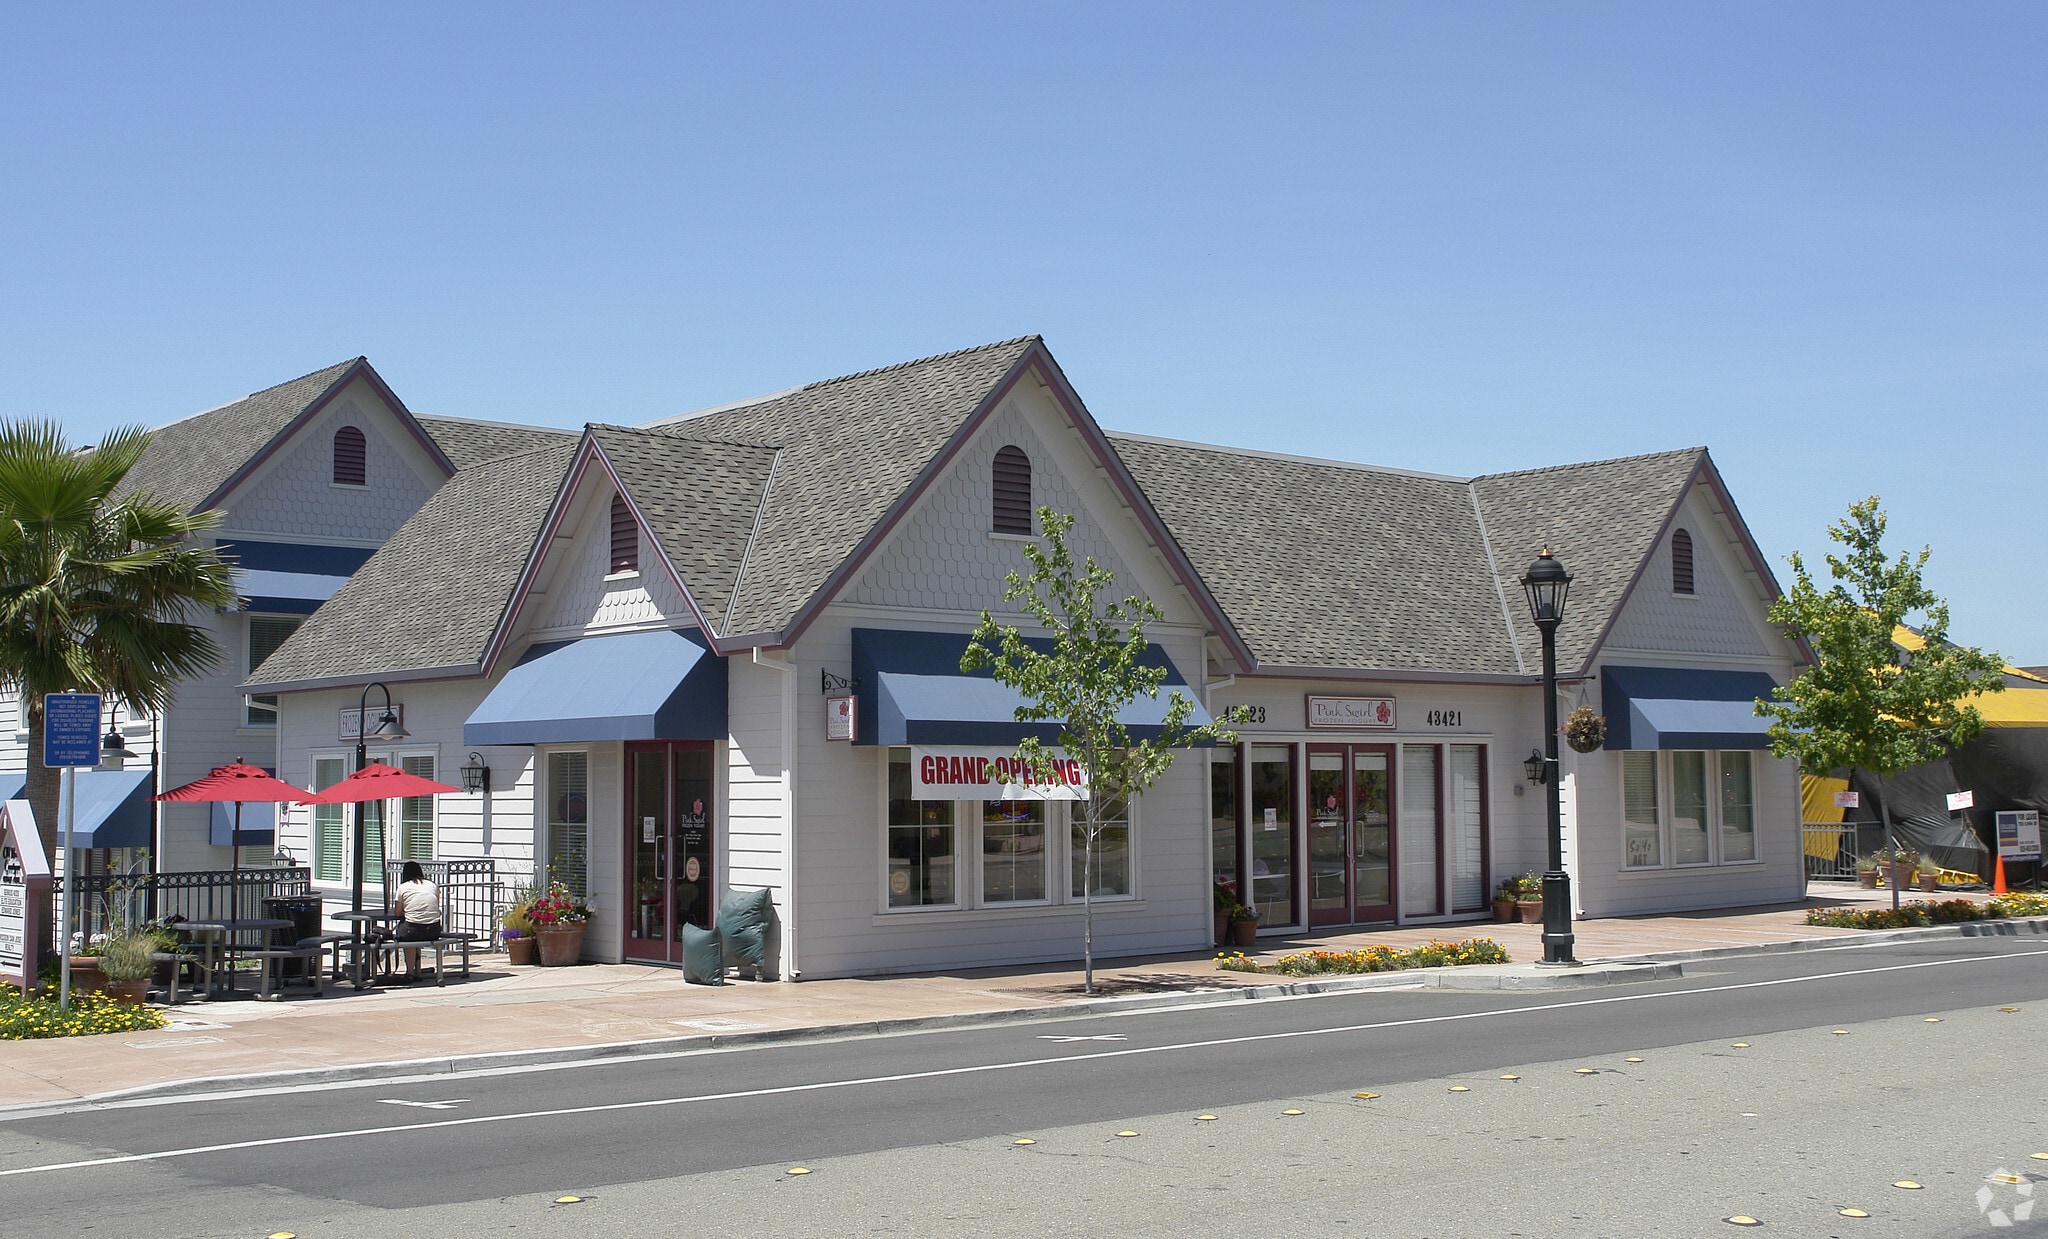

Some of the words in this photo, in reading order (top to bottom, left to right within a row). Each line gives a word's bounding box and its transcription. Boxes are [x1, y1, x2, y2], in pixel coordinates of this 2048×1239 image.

[1223, 705, 1266, 723] 4323
[1315, 701, 1342, 717] Pink
[1345, 702, 1373, 717] Swirl
[1427, 710, 1461, 726] 43421
[342, 714, 361, 733] FROZE
[921, 756, 991, 785] GRAND
